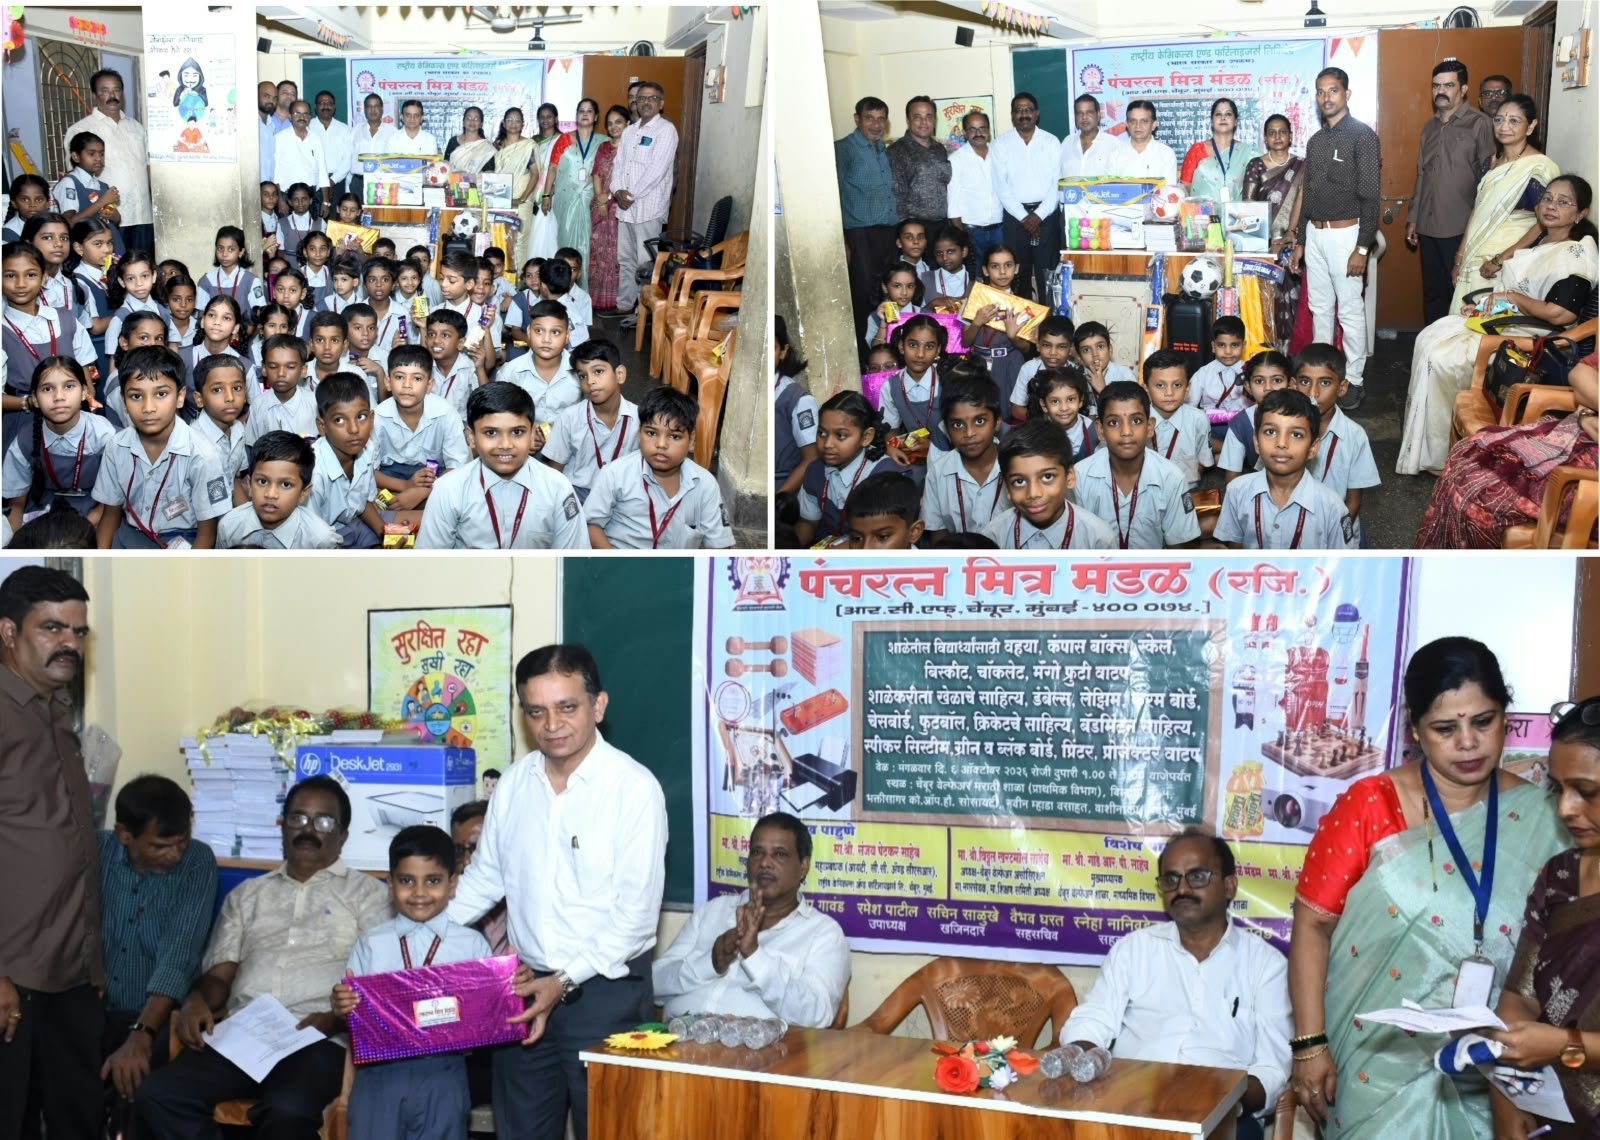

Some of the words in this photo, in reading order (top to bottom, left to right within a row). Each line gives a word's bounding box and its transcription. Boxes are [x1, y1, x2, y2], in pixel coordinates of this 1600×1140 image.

[1157, 49, 1193, 59] केमिकल्स
[378, 79, 422, 91] पंचरत्न
[426, 79, 452, 90] मित्र
[457, 79, 488, 91] मंडळ
[1107, 73, 1164, 89] पंचरत्न
[1170, 71, 1204, 87] मित्र
[1209, 69, 1251, 86] मंडळ
[799, 558, 949, 599] पंचरत्न
[962, 557, 1056, 597] मित्र
[1071, 556, 1191, 595] मंडळ
[1208, 564, 1330, 599] (रजि.)
[1026, 599, 1079, 617] मुंबई
[391, 619, 446, 665] सुरक्षित
[457, 628, 489, 657] रहा
[888, 637, 931, 654] शाळेतील
[1047, 635, 1086, 654] कंपास
[454, 658, 475, 677] रहा
[924, 660, 973, 681] बिस्कीट,
[977, 660, 1029, 682] चॉकलेट,
[1063, 660, 1092, 687] फ्रुटी
[868, 684, 933, 706] शाळेकरीता
[936, 685, 975, 705] खेळाचे
[978, 686, 1028, 709] साहित्य,
[1032, 686, 1075, 708] डंबेल्स,
[1169, 687, 1201, 711] बोर्ड,
[866, 709, 914, 731] चेसबोर्ड,
[918, 711, 970, 734] फुटबॉल,
[973, 711, 1022, 733] क्रिकेटचे
[1025, 712, 1076, 736] साहित्य,
[864, 735, 902, 755] स्पीकर
[984, 741, 994, 756] व
[997, 738, 1026, 757] ब्लॅक
[1029, 738, 1058, 759] बोर्ड,
[1061, 739, 1098, 761] प्रिंटर,
[1165, 747, 1201, 764] वाटप
[302, 753, 319, 775] hp
[330, 752, 385, 772] DeskJet
[875, 760, 889, 773] वेळ
[898, 760, 932, 774] मंगळवार
[934, 761, 948, 774] दि.
[961, 761, 1001, 776] ऑक्टोबर
[1031, 764, 1052, 778] रोजी
[1054, 766, 1079, 781] दुपारी
[1082, 770, 1106, 780] १.००
[886, 778, 907, 789] स्थळ
[915, 777, 933, 793] चेंबूर
[936, 778, 970, 791] वेल्फेअर
[974, 779, 1000, 793] मराठी
[1003, 782, 1025, 794] शाळा
[1028, 782, 1068, 797] (प्राथमिक
[1070, 783, 1106, 799] विभाग),
[1006, 798, 1029, 811] नवीन
[1056, 801, 1091, 814] वसाहत,
[1175, 804, 1197, 820] मुंबई
[821, 823, 856, 840] पाहुणे
[1104, 836, 1143, 851] विशेष
[818, 896, 845, 913] गावंड
[857, 898, 882, 915] रमेश
[885, 900, 919, 917] पाटील
[926, 903, 958, 919] सचिन
[962, 905, 1000, 928] साळुंखे
[1010, 907, 1034, 925] वैभव
[1040, 913, 1064, 927] घरत
[1073, 912, 1103, 932] स्नेहा
[868, 919, 907, 931] उपाध्यक्ष
[940, 921, 985, 937] खजिनदार
[1015, 927, 1058, 942] सहसचिव
